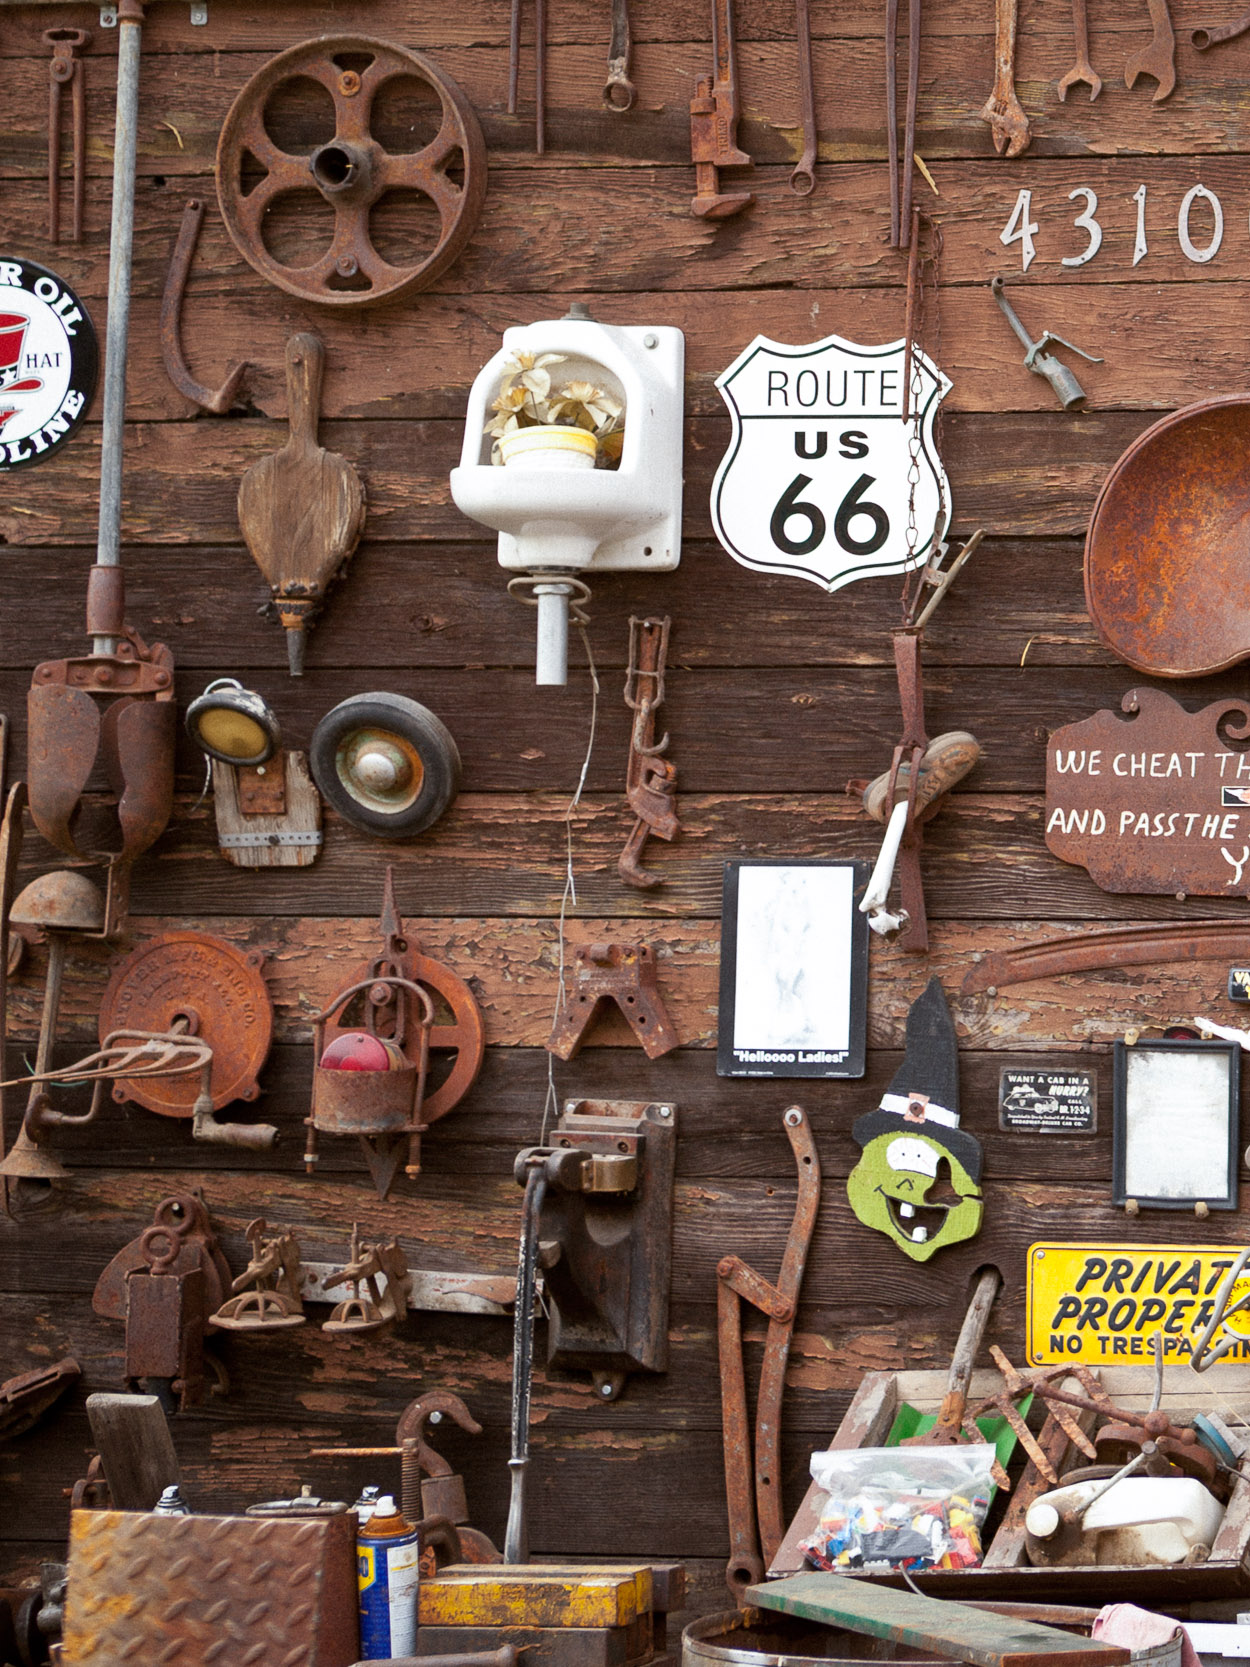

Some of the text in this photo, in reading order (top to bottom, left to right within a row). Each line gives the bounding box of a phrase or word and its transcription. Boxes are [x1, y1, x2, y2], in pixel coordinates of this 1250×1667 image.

[34, 277, 83, 335] OIL
[26, 352, 63, 369] HAT
[767, 370, 898, 407] ROUTE
[794, 430, 870, 460] US
[770, 473, 890, 556] 66
[1055, 749, 1101, 777] WE
[1112, 752, 1205, 778] CHEAT
[1046, 808, 1107, 836] AND
[1118, 811, 1179, 837] PASS
[1182, 813, 1240, 840] THE
[798, 1051, 850, 1063] Ladies!"
[1008, 1075, 1035, 1083] WANT
[1037, 1076, 1045, 1084] A
[1047, 1076, 1065, 1084] CAB
[1082, 1077, 1089, 1085] A
[1048, 1085, 1090, 1097] HURRY?
[1051, 1296, 1228, 1334] PROPER
[1050, 1334, 1083, 1354] NO
